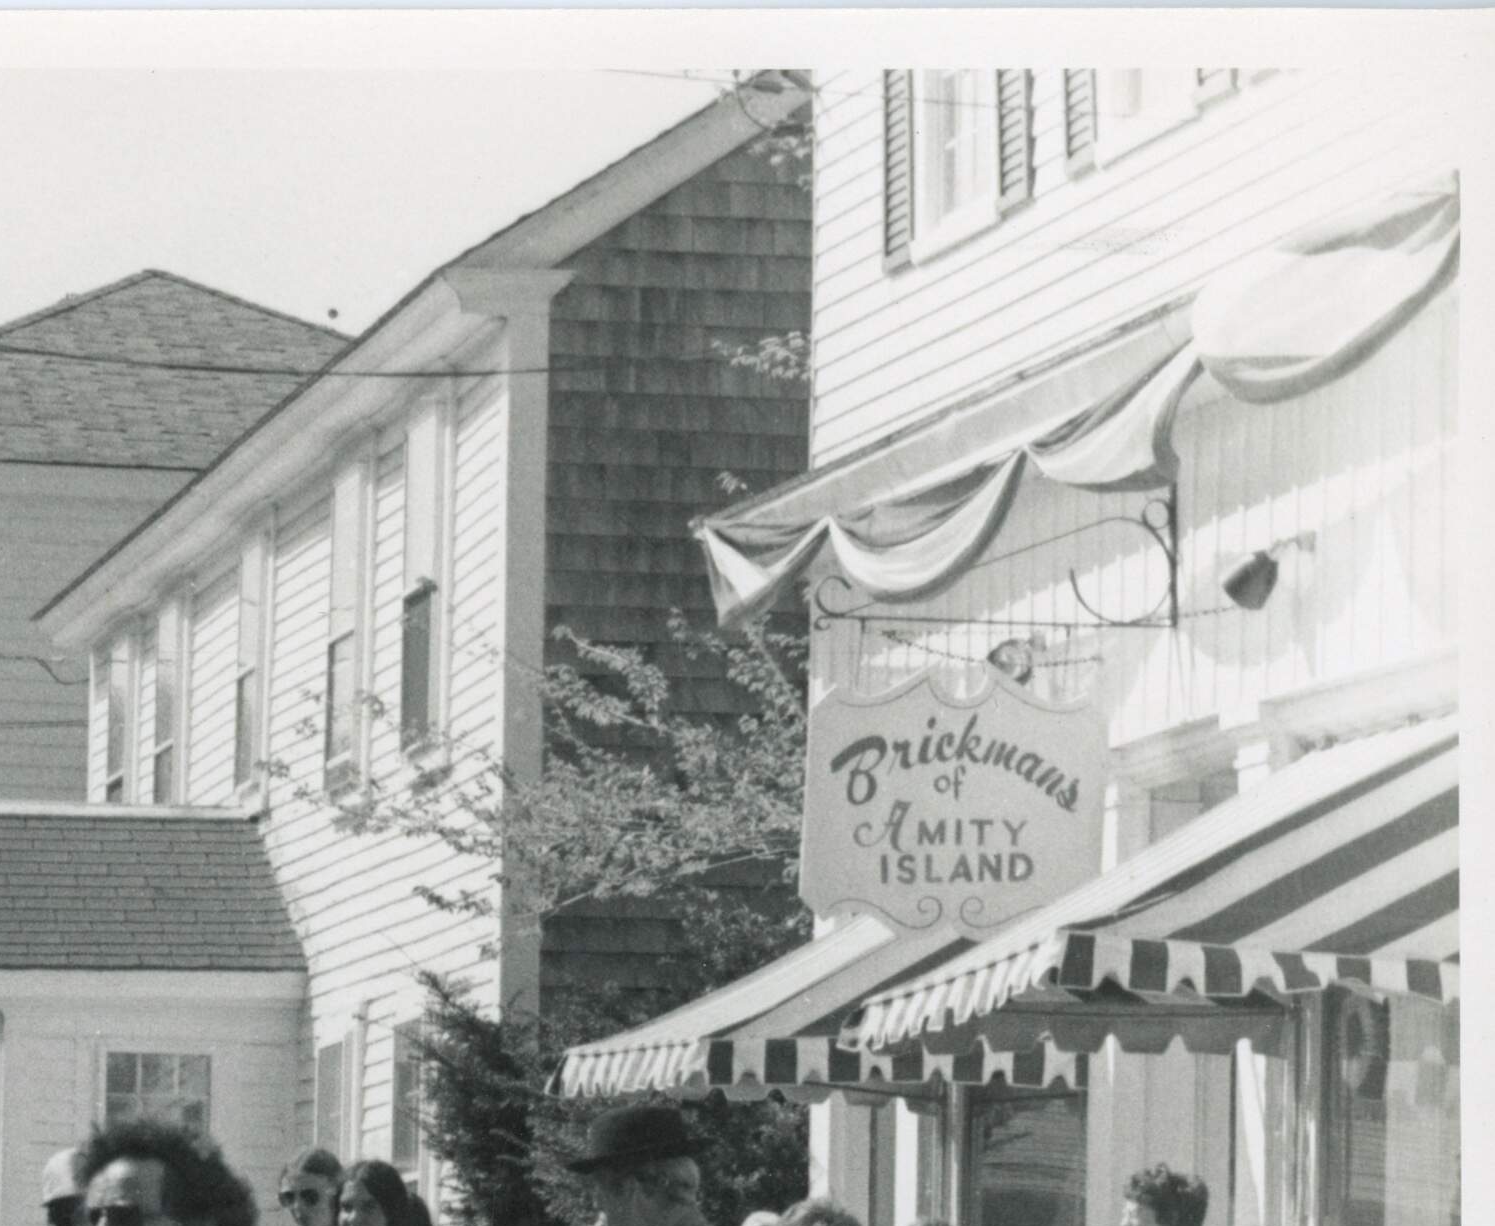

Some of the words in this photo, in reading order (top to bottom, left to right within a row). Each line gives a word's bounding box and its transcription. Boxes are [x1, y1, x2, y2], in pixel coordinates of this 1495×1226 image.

[830, 713, 1081, 813] Brickmans
[933, 766, 967, 800] of
[852, 800, 1028, 852] AMITY
[880, 852, 1035, 885] ISLAND
